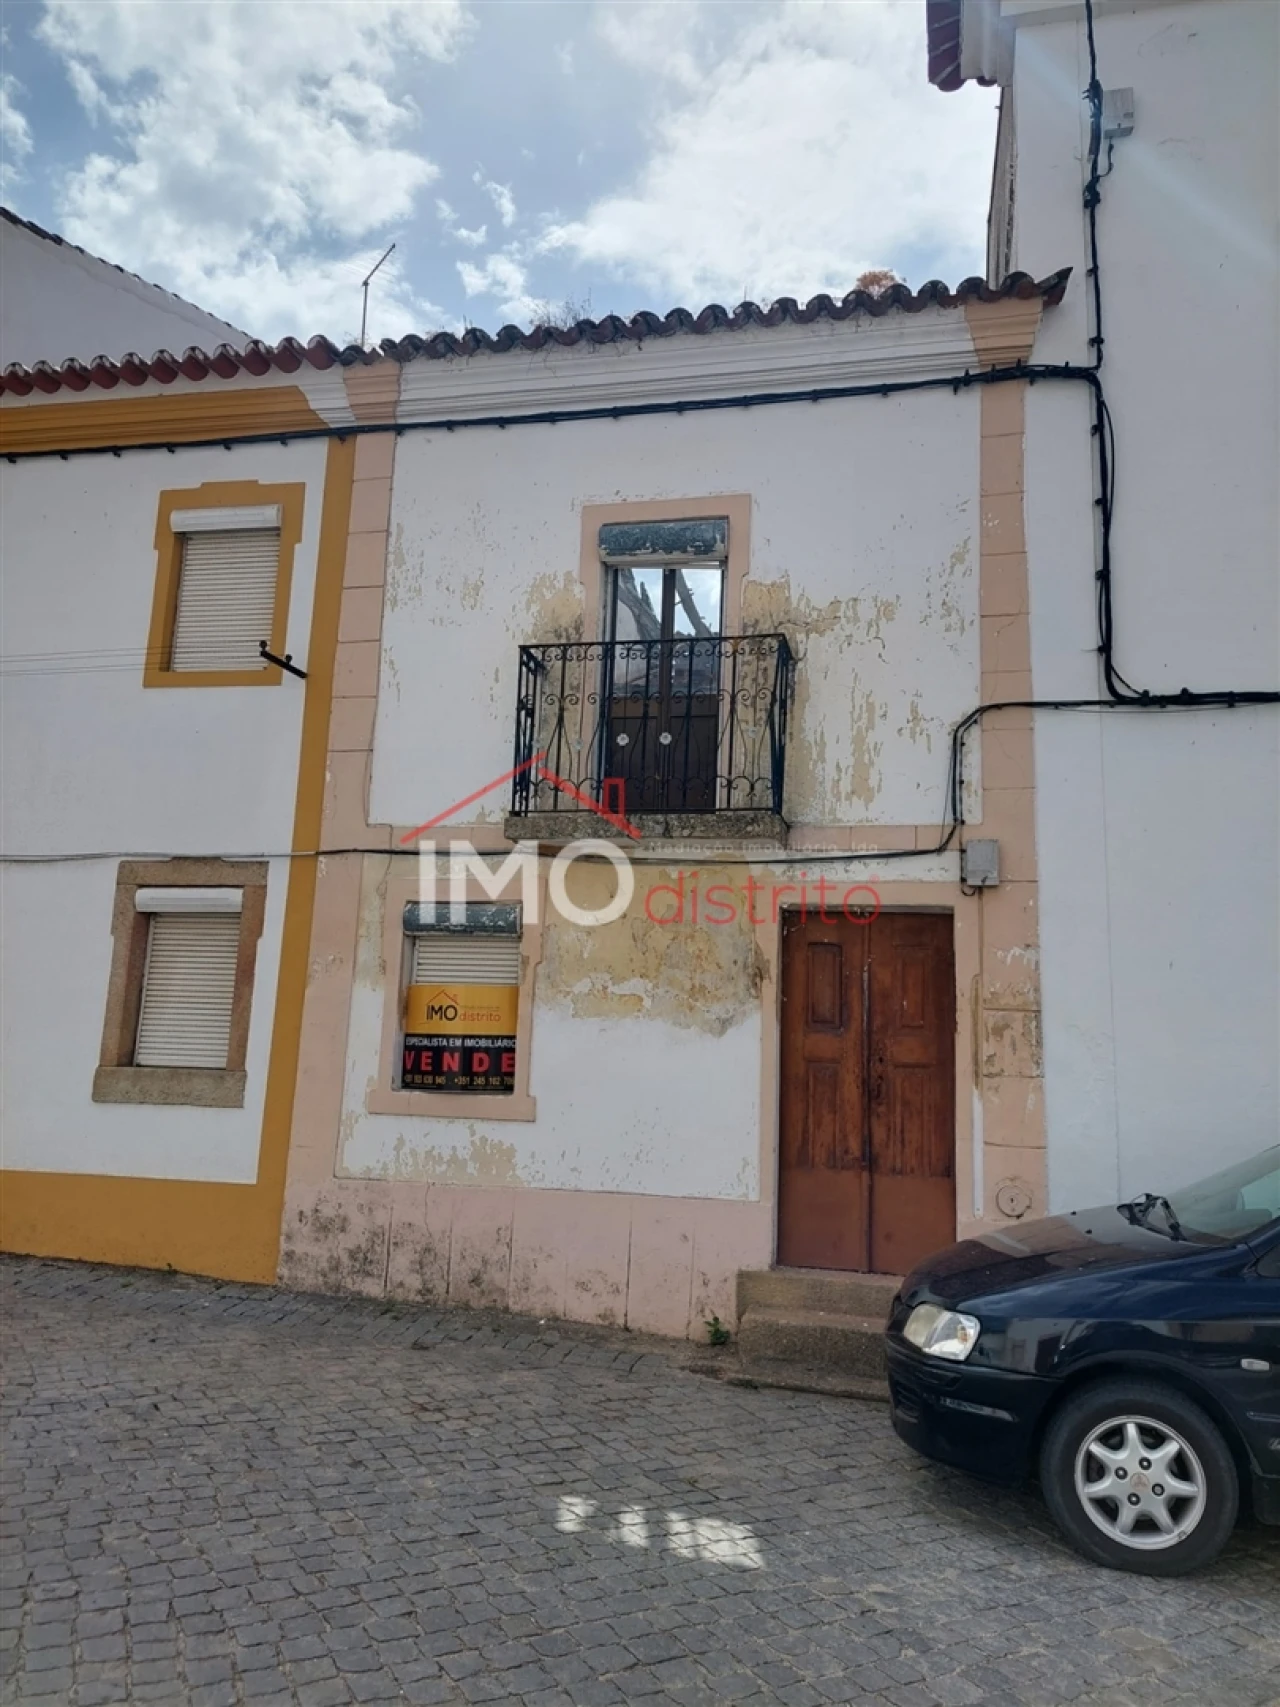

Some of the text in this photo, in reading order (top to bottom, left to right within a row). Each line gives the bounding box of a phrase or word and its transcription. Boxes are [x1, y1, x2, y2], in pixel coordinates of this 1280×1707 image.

[426, 1004, 502, 1022] IMO distrito
[449, 1037, 462, 1047] EM
[404, 1050, 516, 1073] VENDE
